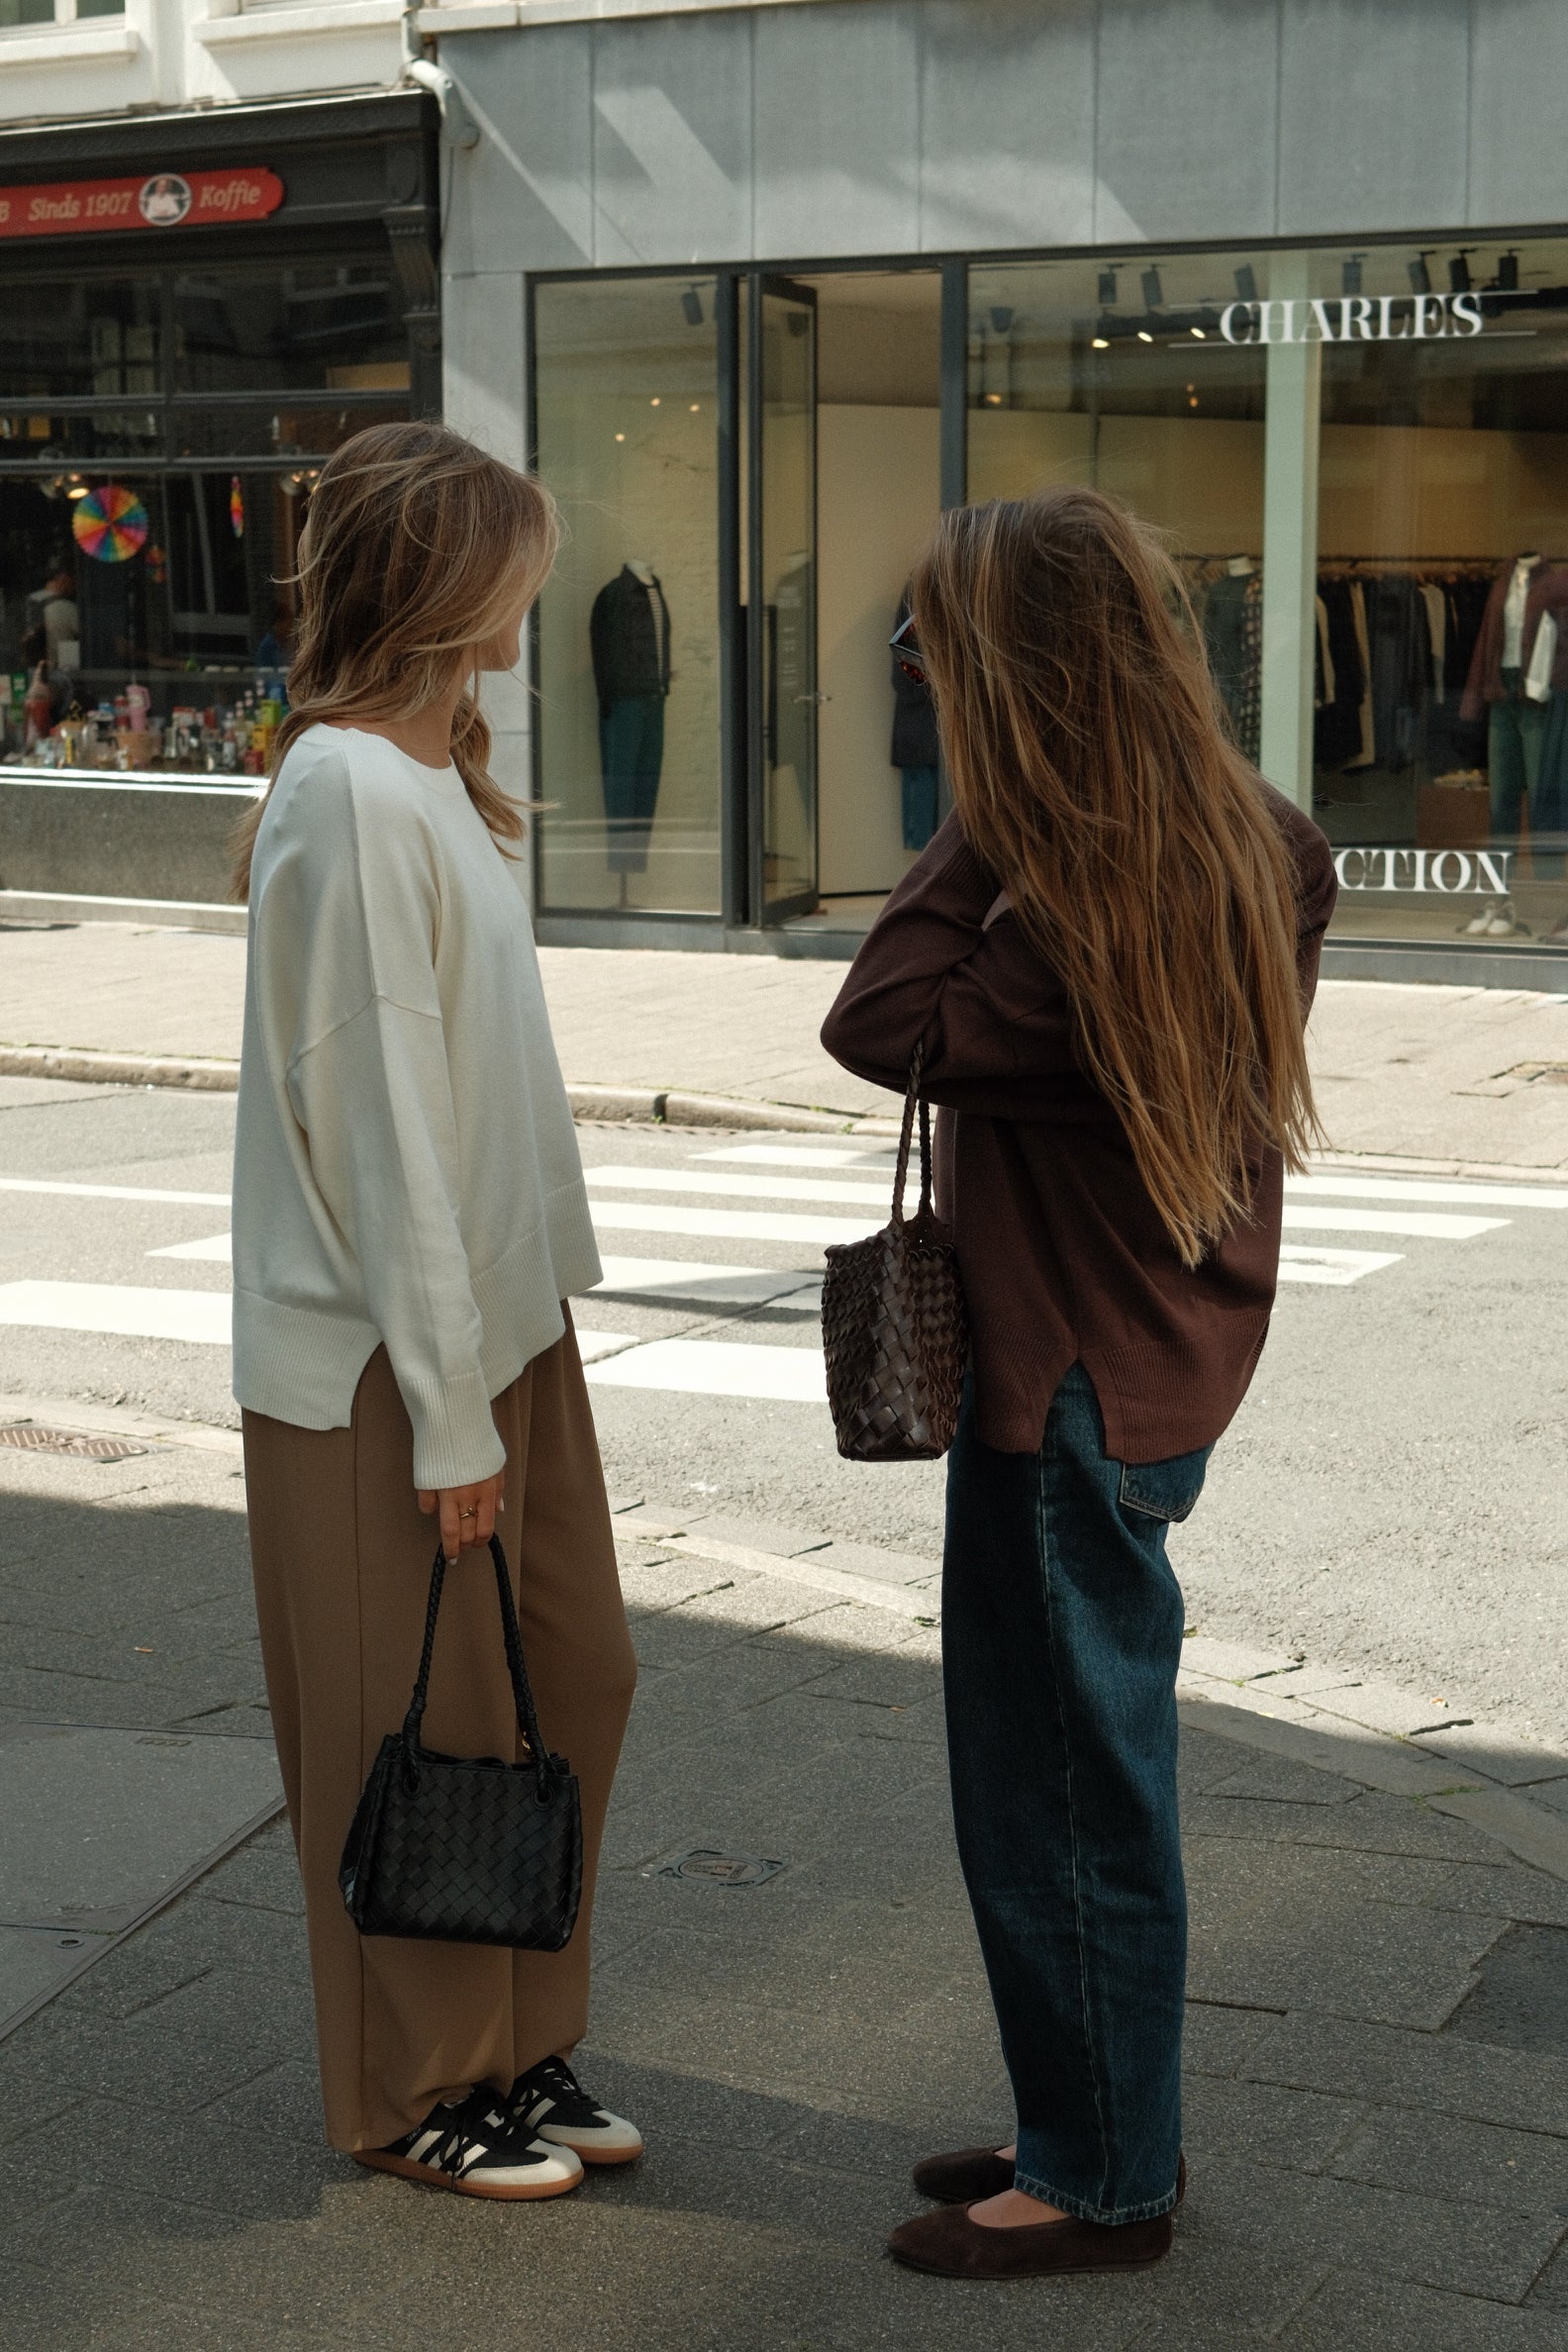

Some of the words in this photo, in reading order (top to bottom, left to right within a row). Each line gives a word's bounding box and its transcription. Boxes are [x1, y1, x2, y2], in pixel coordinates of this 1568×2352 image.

[28, 192, 80, 221] Sinds
[85, 190, 134, 217] 1907
[199, 179, 260, 211] Koffie
[1220, 292, 1483, 344] CHARLES
